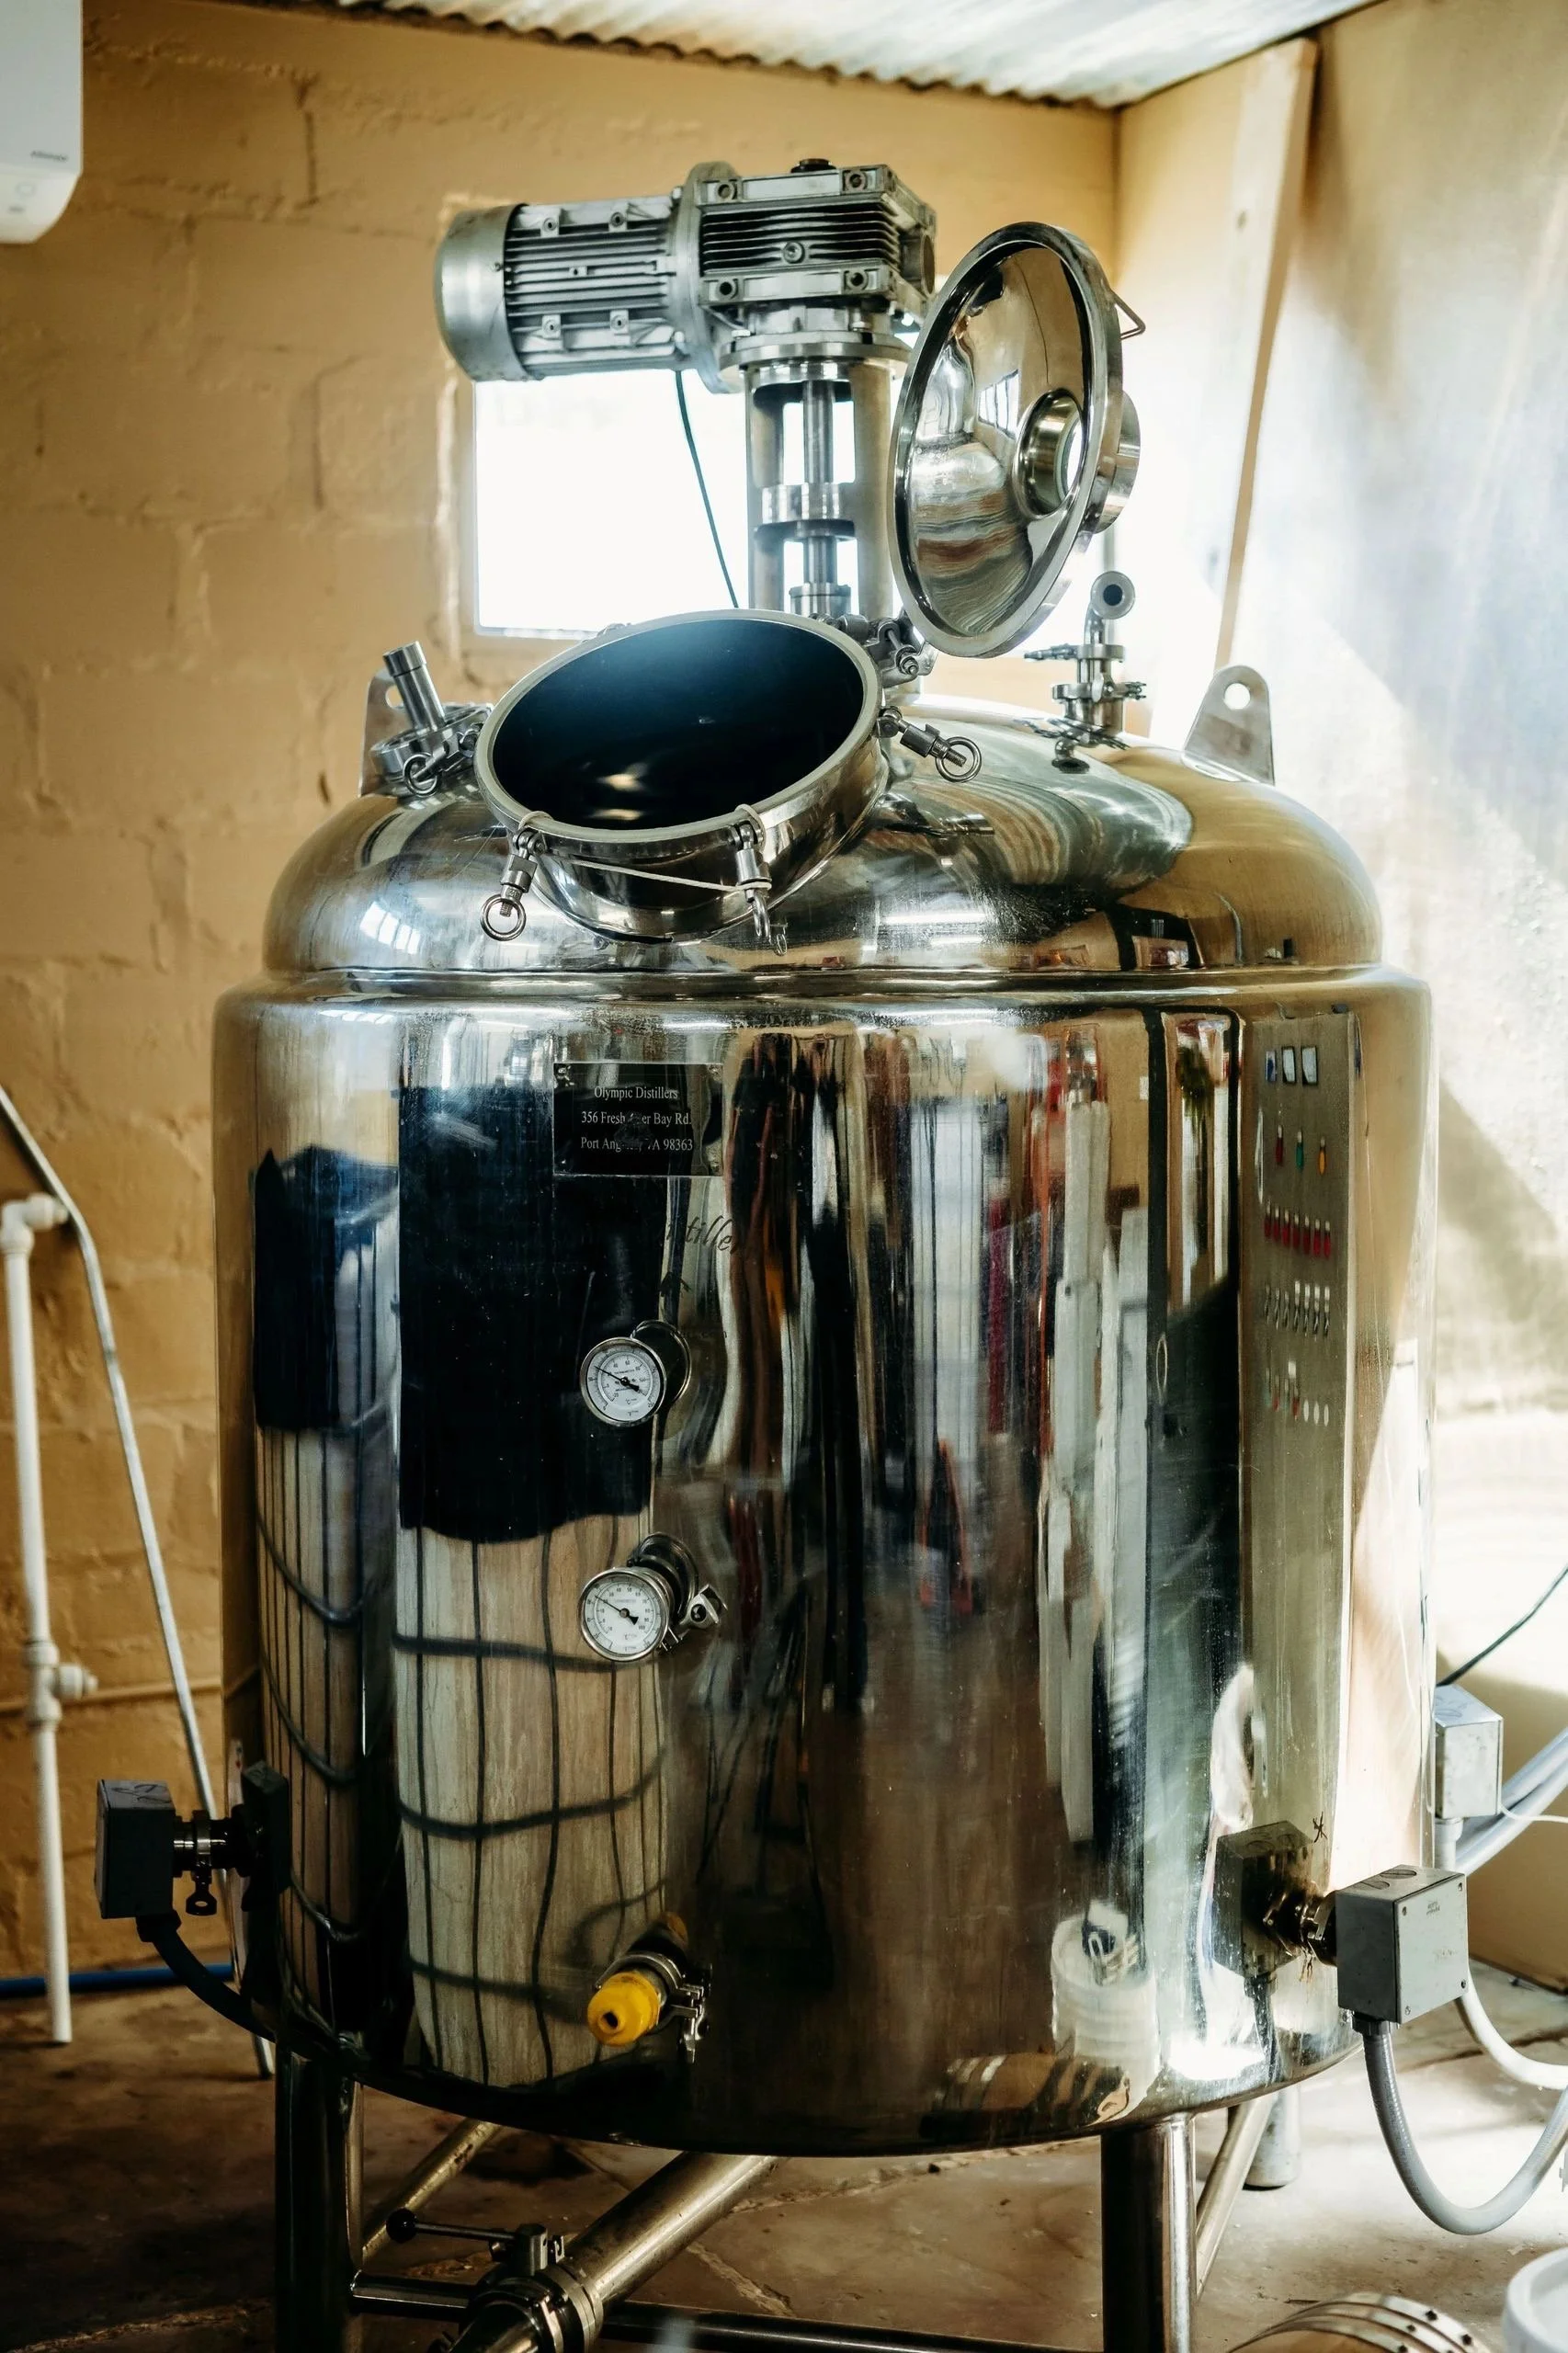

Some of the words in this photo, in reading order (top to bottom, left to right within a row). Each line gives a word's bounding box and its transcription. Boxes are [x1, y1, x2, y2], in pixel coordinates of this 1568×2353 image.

[594, 1086, 633, 1102] Olympic
[635, 1086, 679, 1100] Distillers
[581, 1110, 598, 1124] 356
[600, 1110, 652, 1125] Fresher
[653, 1112, 673, 1128] Bay
[580, 1136, 599, 1149] Port
[663, 1139, 693, 1152] 98363
